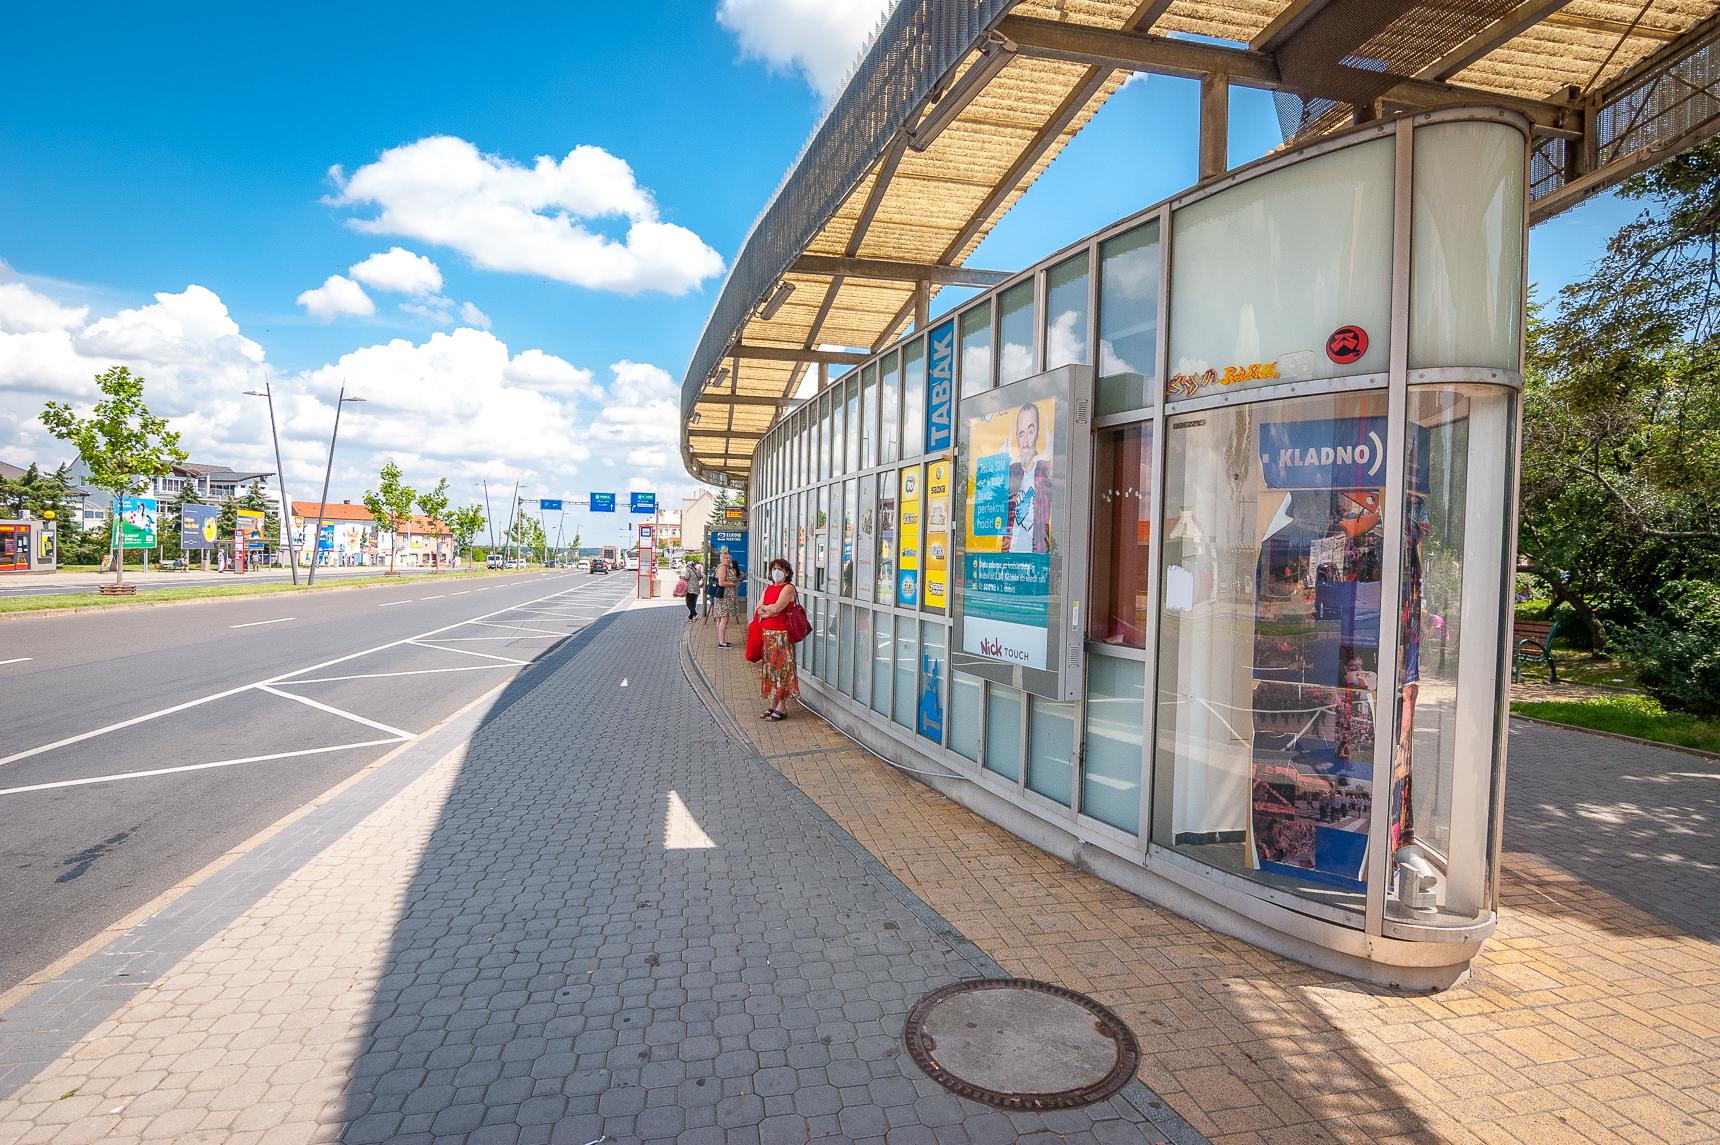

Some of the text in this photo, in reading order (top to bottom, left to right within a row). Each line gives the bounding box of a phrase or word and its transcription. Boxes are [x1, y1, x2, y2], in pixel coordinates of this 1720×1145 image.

[930, 331, 952, 446] TABÁK
[1280, 444, 1370, 467] KLADNO
[981, 637, 1029, 661] Nick TOUCH
